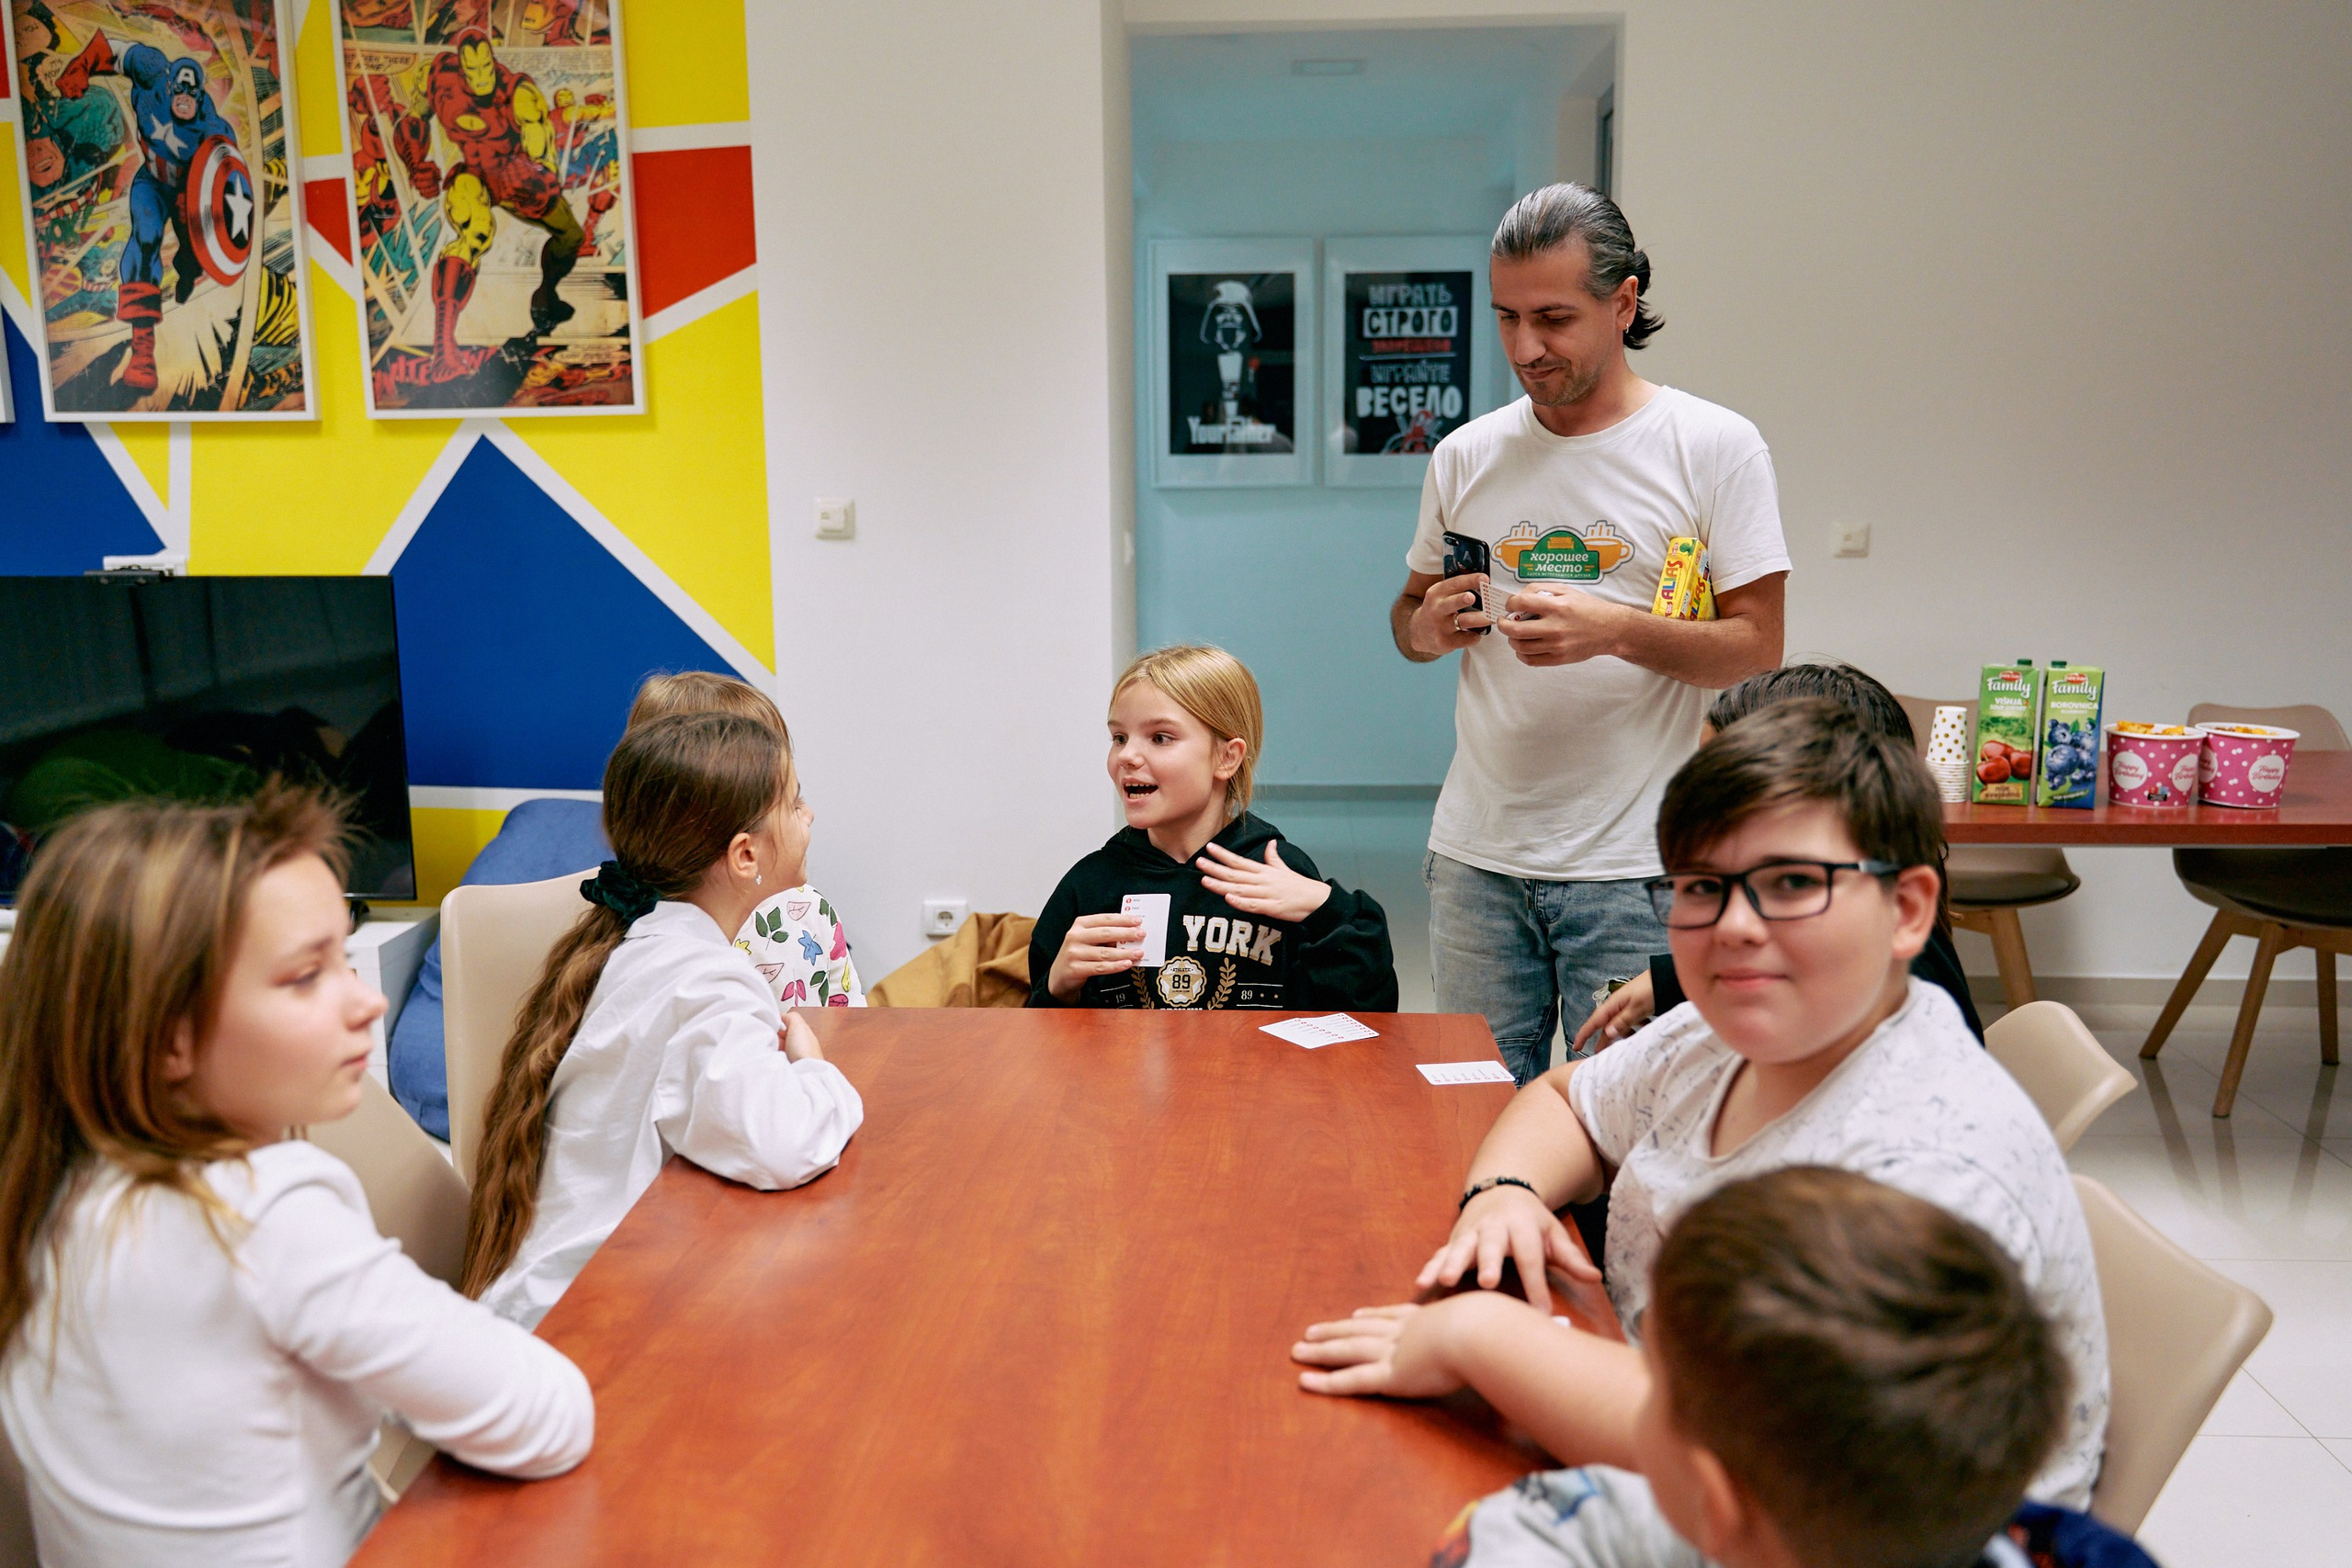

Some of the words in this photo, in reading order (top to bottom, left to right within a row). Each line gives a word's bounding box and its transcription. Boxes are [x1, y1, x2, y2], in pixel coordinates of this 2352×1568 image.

[1368, 283, 1453, 307] ИГРАТЬ
[1368, 310, 1453, 333] СТРОГО
[1355, 386, 1463, 419] ВЕСЕЛО
[1530, 553, 1589, 564] хорошее
[1535, 563, 1583, 573] место
[1661, 559, 1683, 600] ALIAS
[1986, 676, 2031, 699] Family
[2052, 680, 2098, 702] Family
[2050, 701, 2099, 710] BOROVNICA
[1182, 915, 1282, 965] YORK
[1172, 975, 1191, 989] 89
[1115, 993, 1125, 1004] 19
[1240, 990, 1253, 1000] 89
